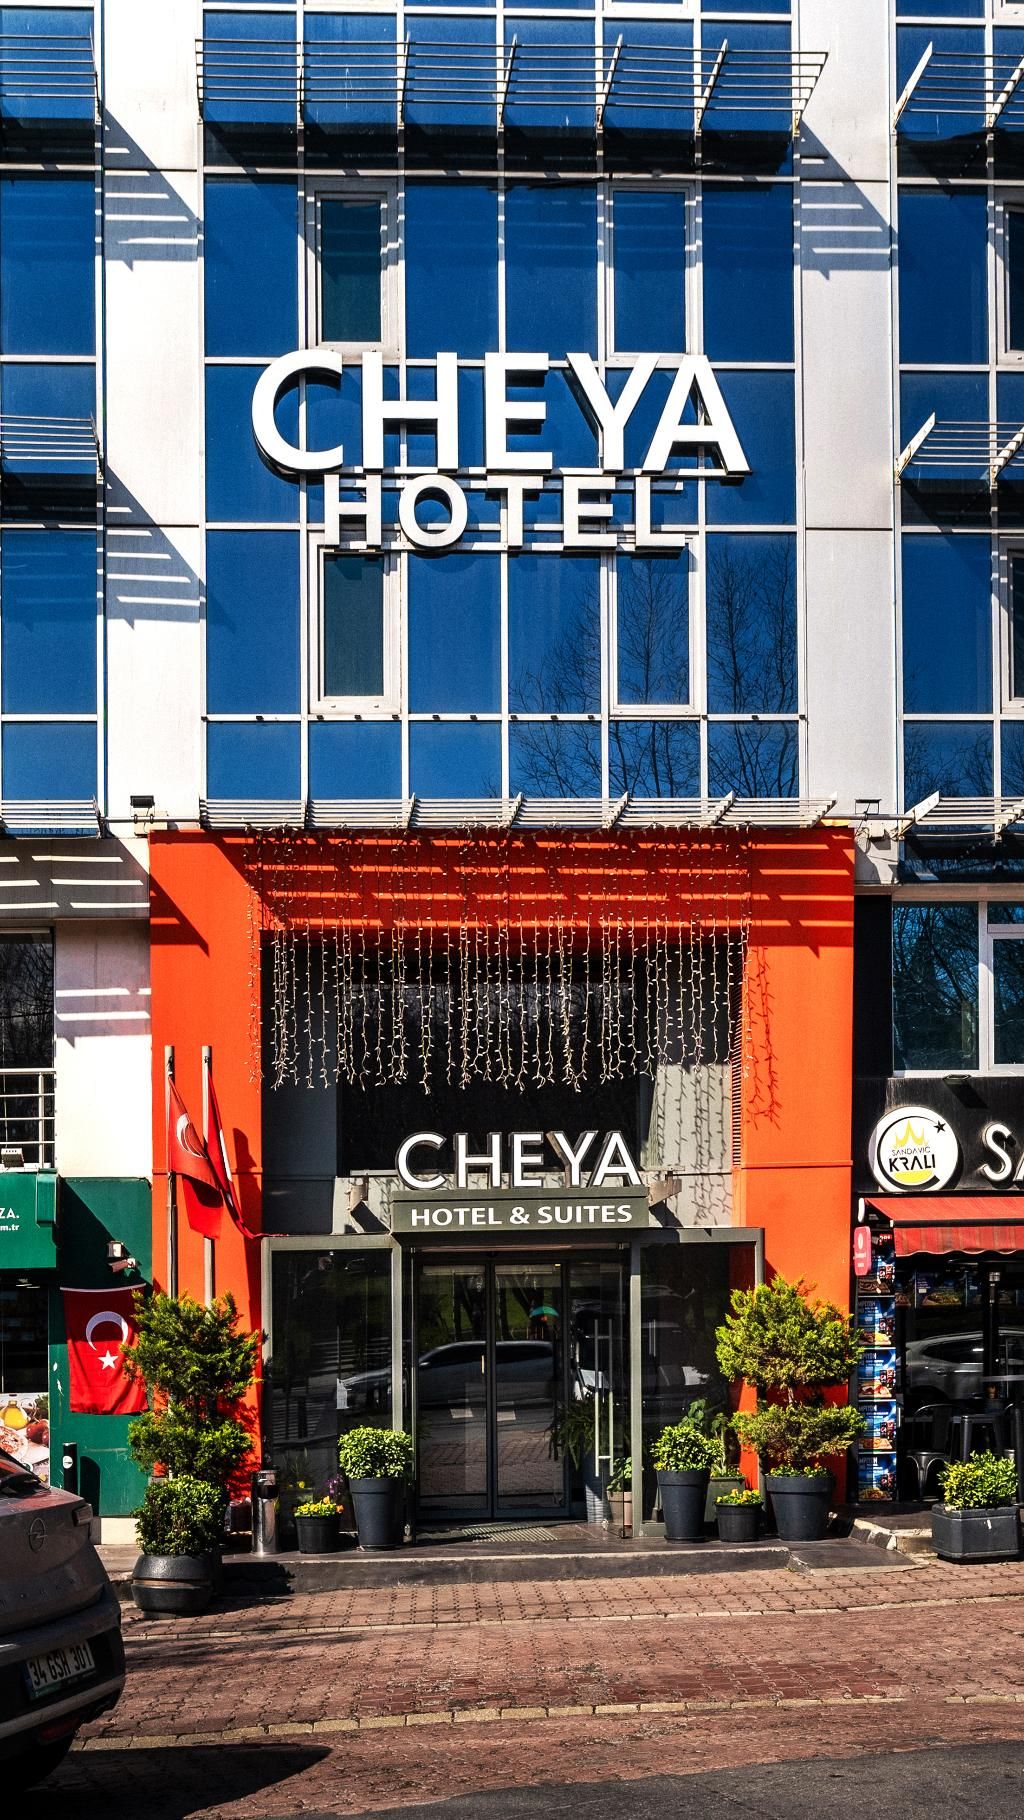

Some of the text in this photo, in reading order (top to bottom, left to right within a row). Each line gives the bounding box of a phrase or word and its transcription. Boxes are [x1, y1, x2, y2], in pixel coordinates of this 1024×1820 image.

[251, 349, 751, 474] CHEYA
[323, 474, 688, 550] HOTEL
[395, 1130, 642, 1189] CHEYA
[889, 1154, 936, 1172] KRALI
[980, 1121, 1024, 1182] S
[411, 1204, 633, 1227] HOTEL & SUITES
[30, 1660, 47, 1686] 34
[71, 1645, 92, 1671] 301
